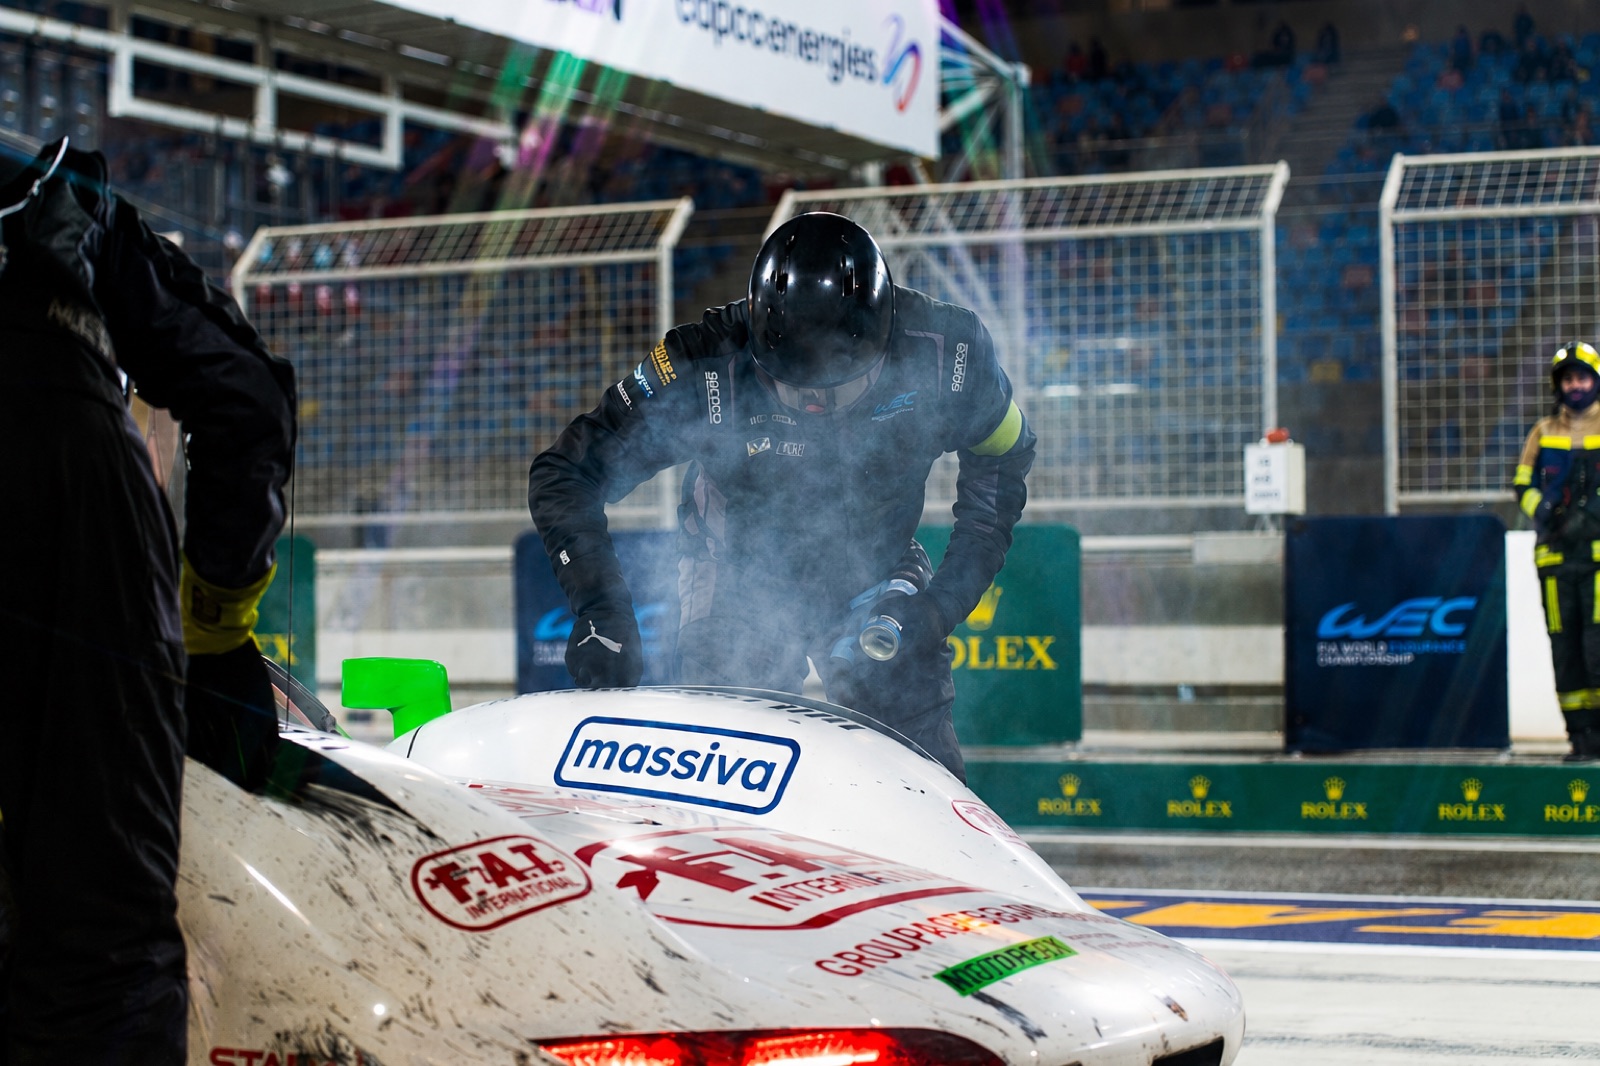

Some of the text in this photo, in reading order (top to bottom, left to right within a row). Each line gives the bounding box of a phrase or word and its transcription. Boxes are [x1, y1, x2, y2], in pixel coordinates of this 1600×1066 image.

[1317, 596, 1477, 638] WEC
[947, 635, 1058, 670] OLEX
[573, 739, 777, 792] massiva
[1038, 798, 1101, 816] ROLEX
[1167, 800, 1232, 818] ROLEX
[1302, 802, 1368, 820] ROLEX
[1438, 803, 1505, 821] ROLEX
[1544, 804, 1600, 823] ROLE
